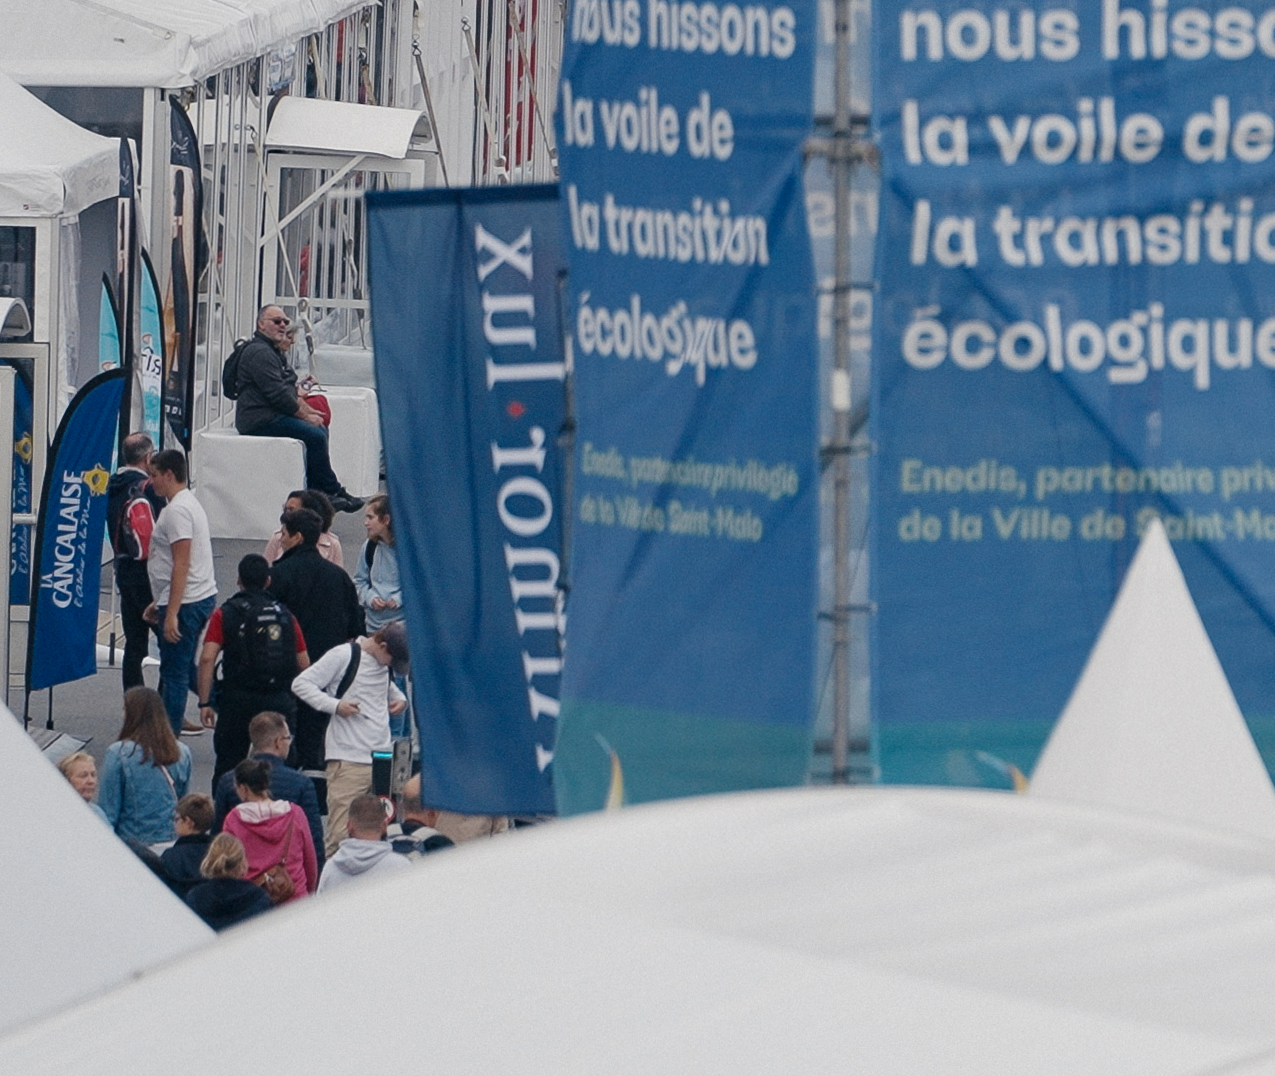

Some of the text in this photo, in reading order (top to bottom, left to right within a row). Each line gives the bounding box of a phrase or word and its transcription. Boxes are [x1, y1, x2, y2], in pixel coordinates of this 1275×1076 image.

[900, 7, 1082, 65] nous
[562, 81, 734, 162] la voile de
[902, 98, 970, 167] la
[990, 95, 1165, 167] voile
[568, 184, 770, 267] la transition
[910, 199, 978, 271] la
[577, 295, 757, 389] écologique
[900, 457, 1028, 502] Enedis,
[1035, 461, 1214, 504] partenaire
[52, 469, 85, 609] CANCALAISE
[898, 509, 942, 546] de
[949, 509, 985, 545] la
[990, 508, 1073, 546] Ville
[1081, 509, 1127, 546] de
[41, 573, 53, 588] LA
